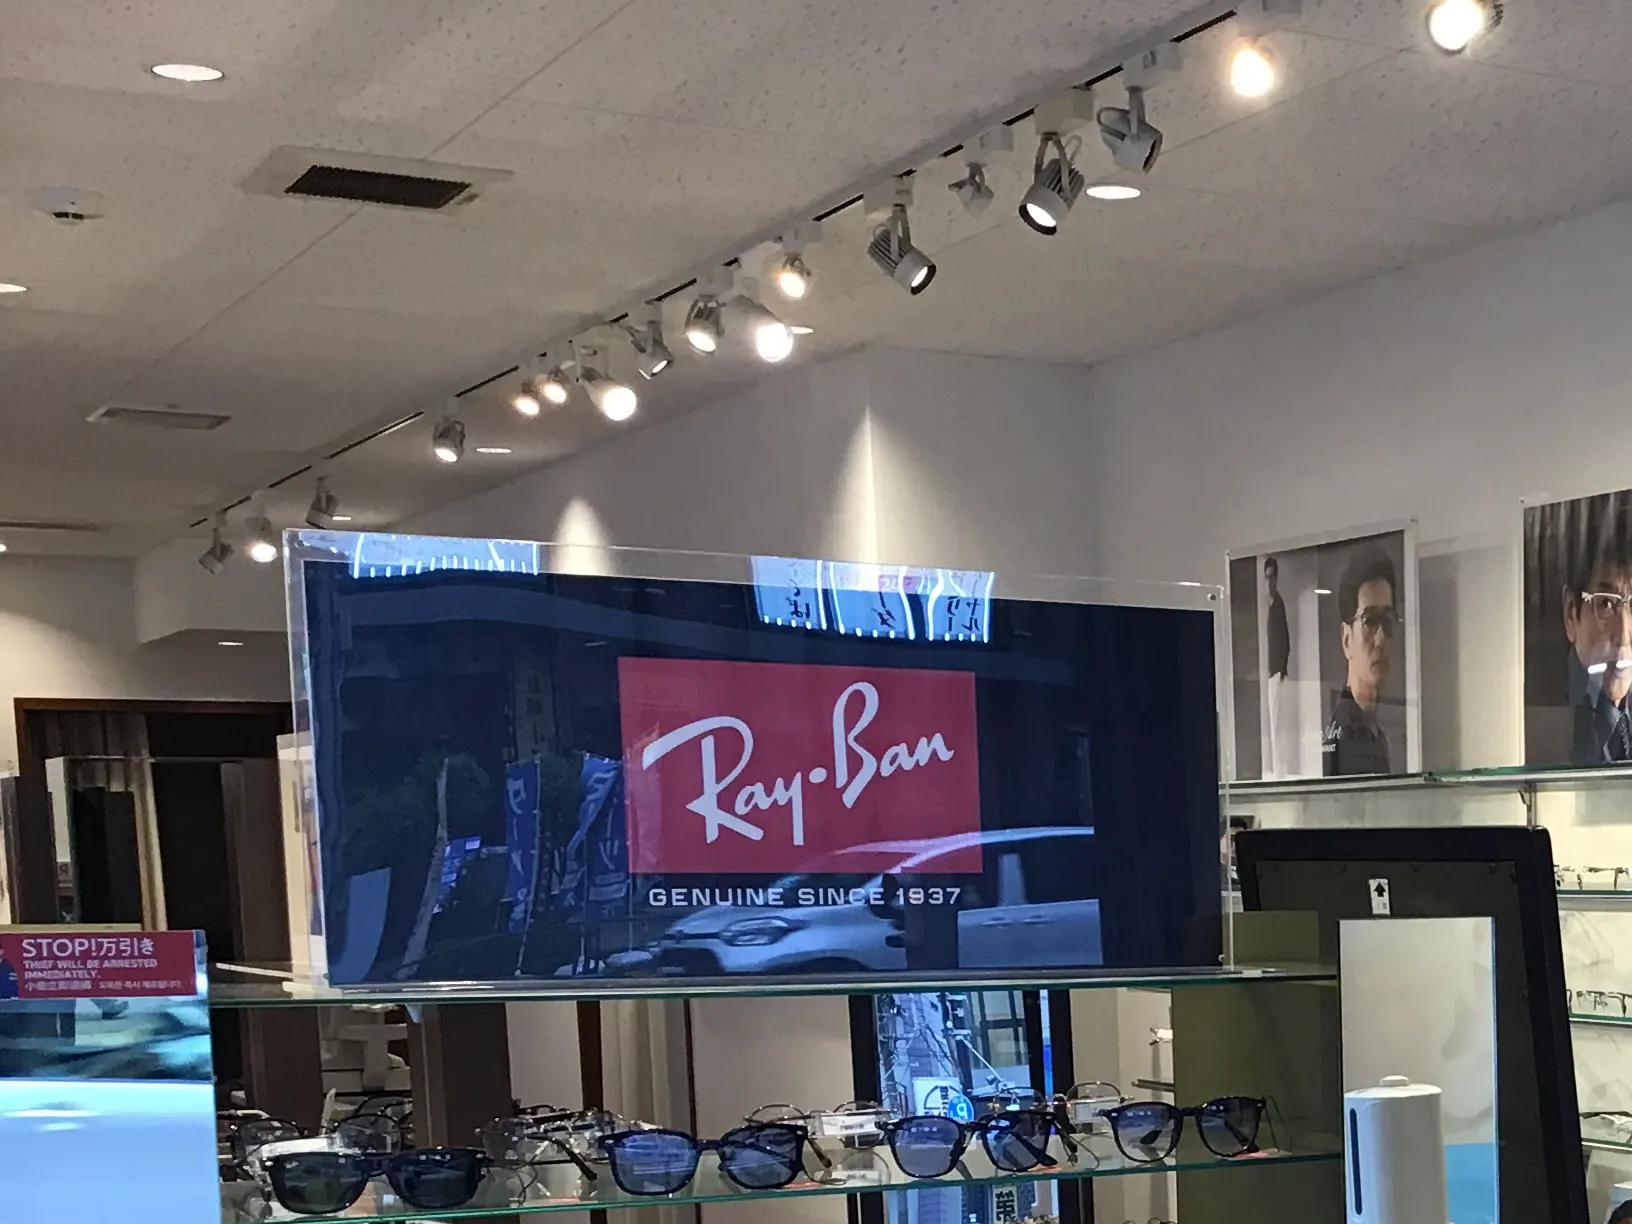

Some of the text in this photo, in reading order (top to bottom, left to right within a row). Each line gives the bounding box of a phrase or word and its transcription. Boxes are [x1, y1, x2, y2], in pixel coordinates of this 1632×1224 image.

[648, 886, 962, 908] GENUINE SINCE 1937
